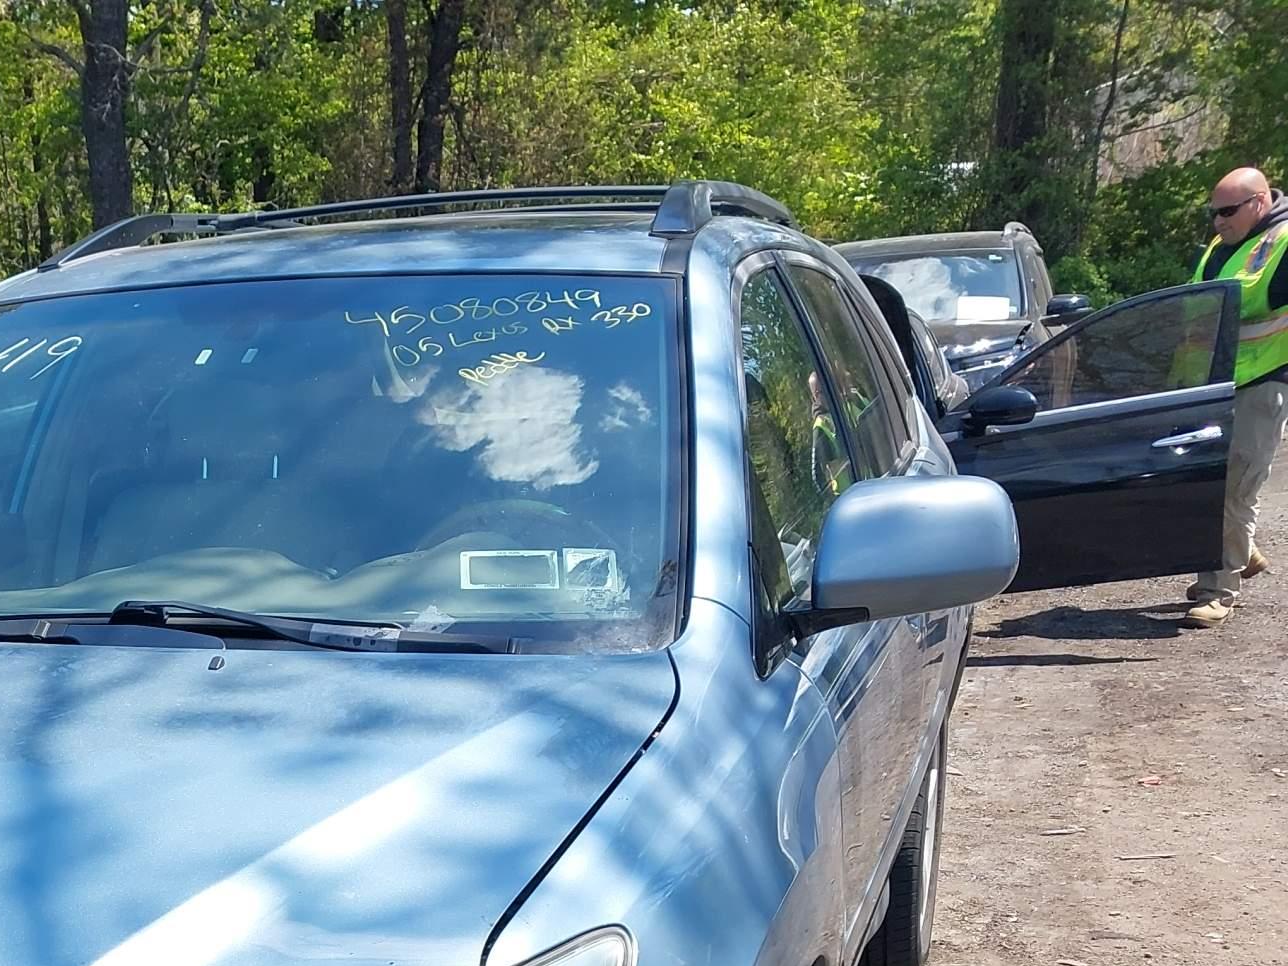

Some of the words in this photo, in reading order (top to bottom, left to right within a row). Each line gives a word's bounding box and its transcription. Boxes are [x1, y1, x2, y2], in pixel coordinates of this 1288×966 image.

[344, 288, 601, 338] 45080849
[392, 336, 444, 367] 05
[590, 302, 652, 329] 330
